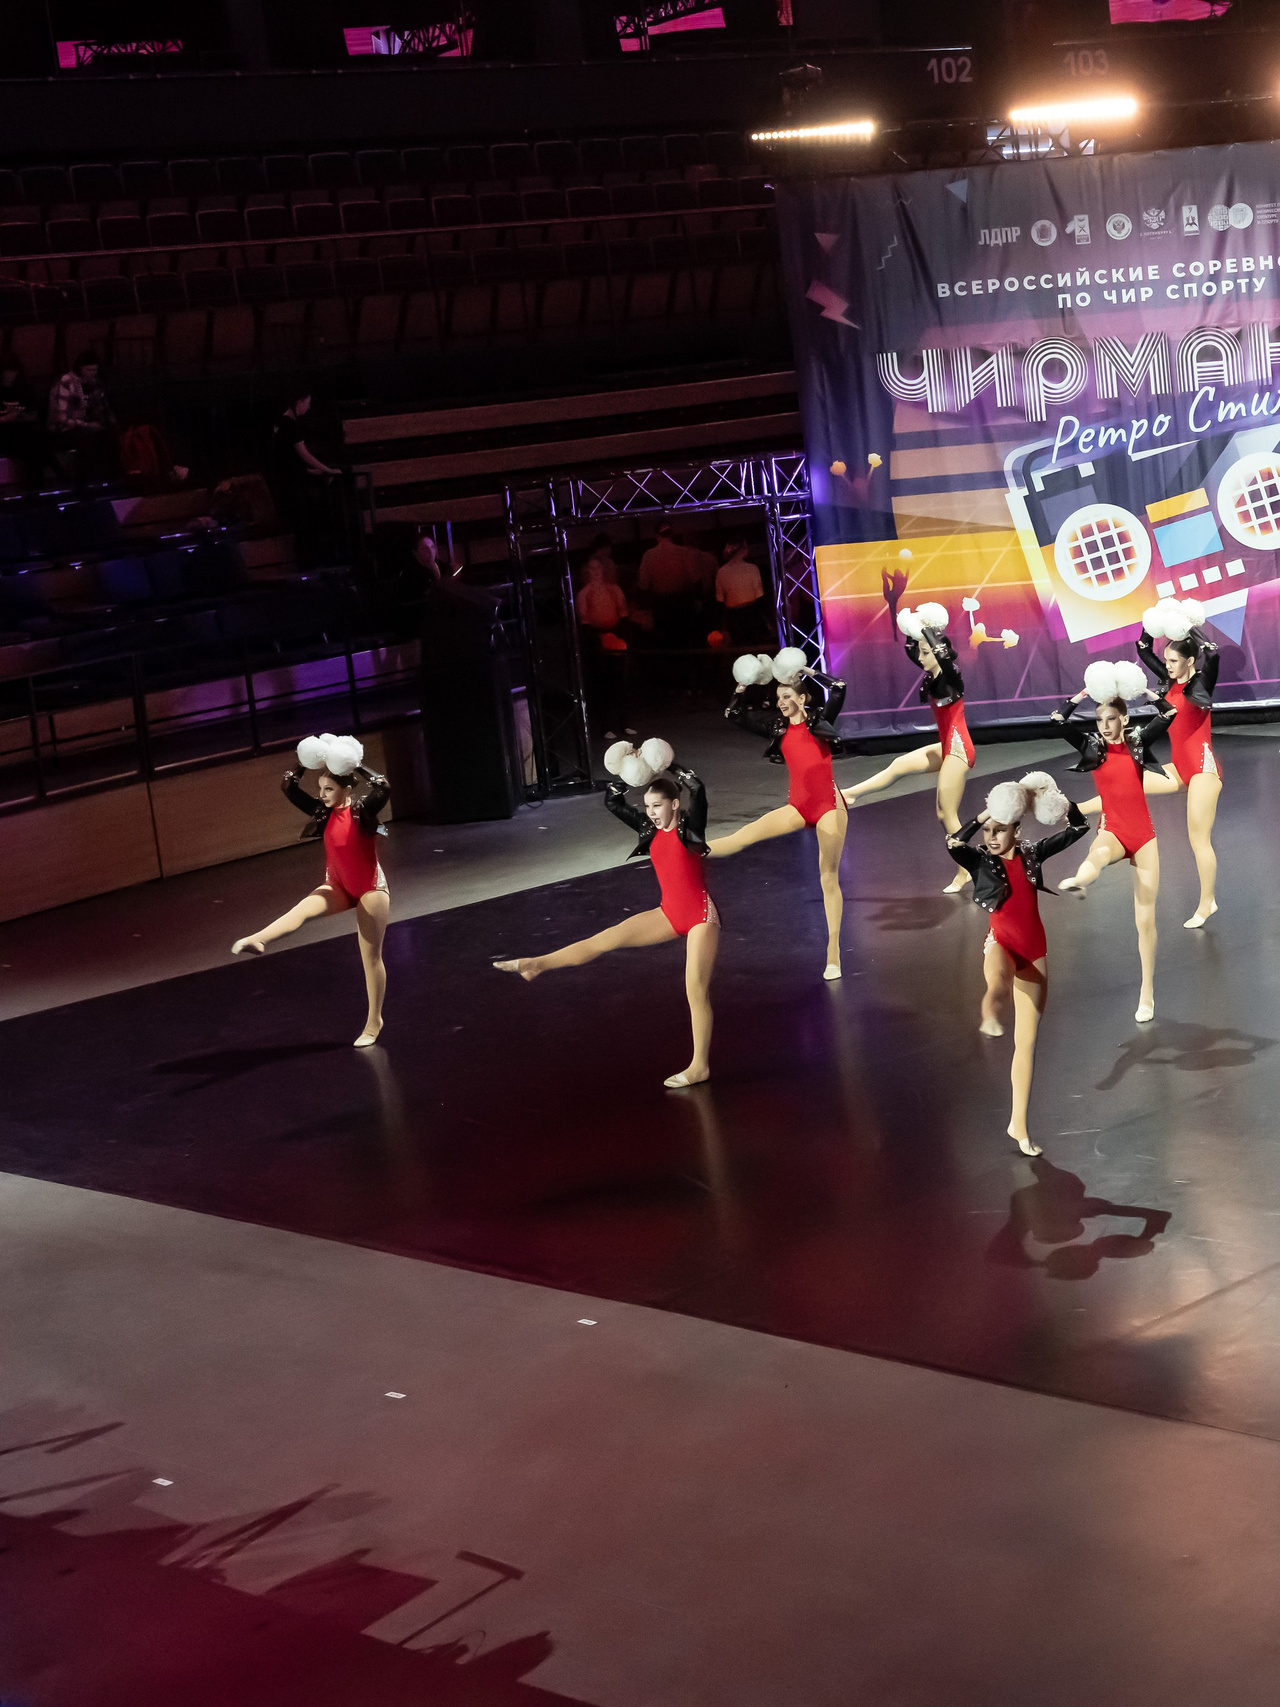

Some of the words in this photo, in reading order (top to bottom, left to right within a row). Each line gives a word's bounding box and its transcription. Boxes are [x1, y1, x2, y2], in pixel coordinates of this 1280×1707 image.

[926, 56, 973, 84] 102
[1063, 49, 1109, 77] 103
[978, 226, 1021, 247] ЛДПР
[937, 265, 1160, 298] ВСЕРОССИЙСКИЕ
[1057, 292, 1091, 309] ПО
[1103, 287, 1155, 305] ЧИР
[1166, 277, 1267, 300] СПОРТУ
[1050, 415, 1172, 464] Ретро
